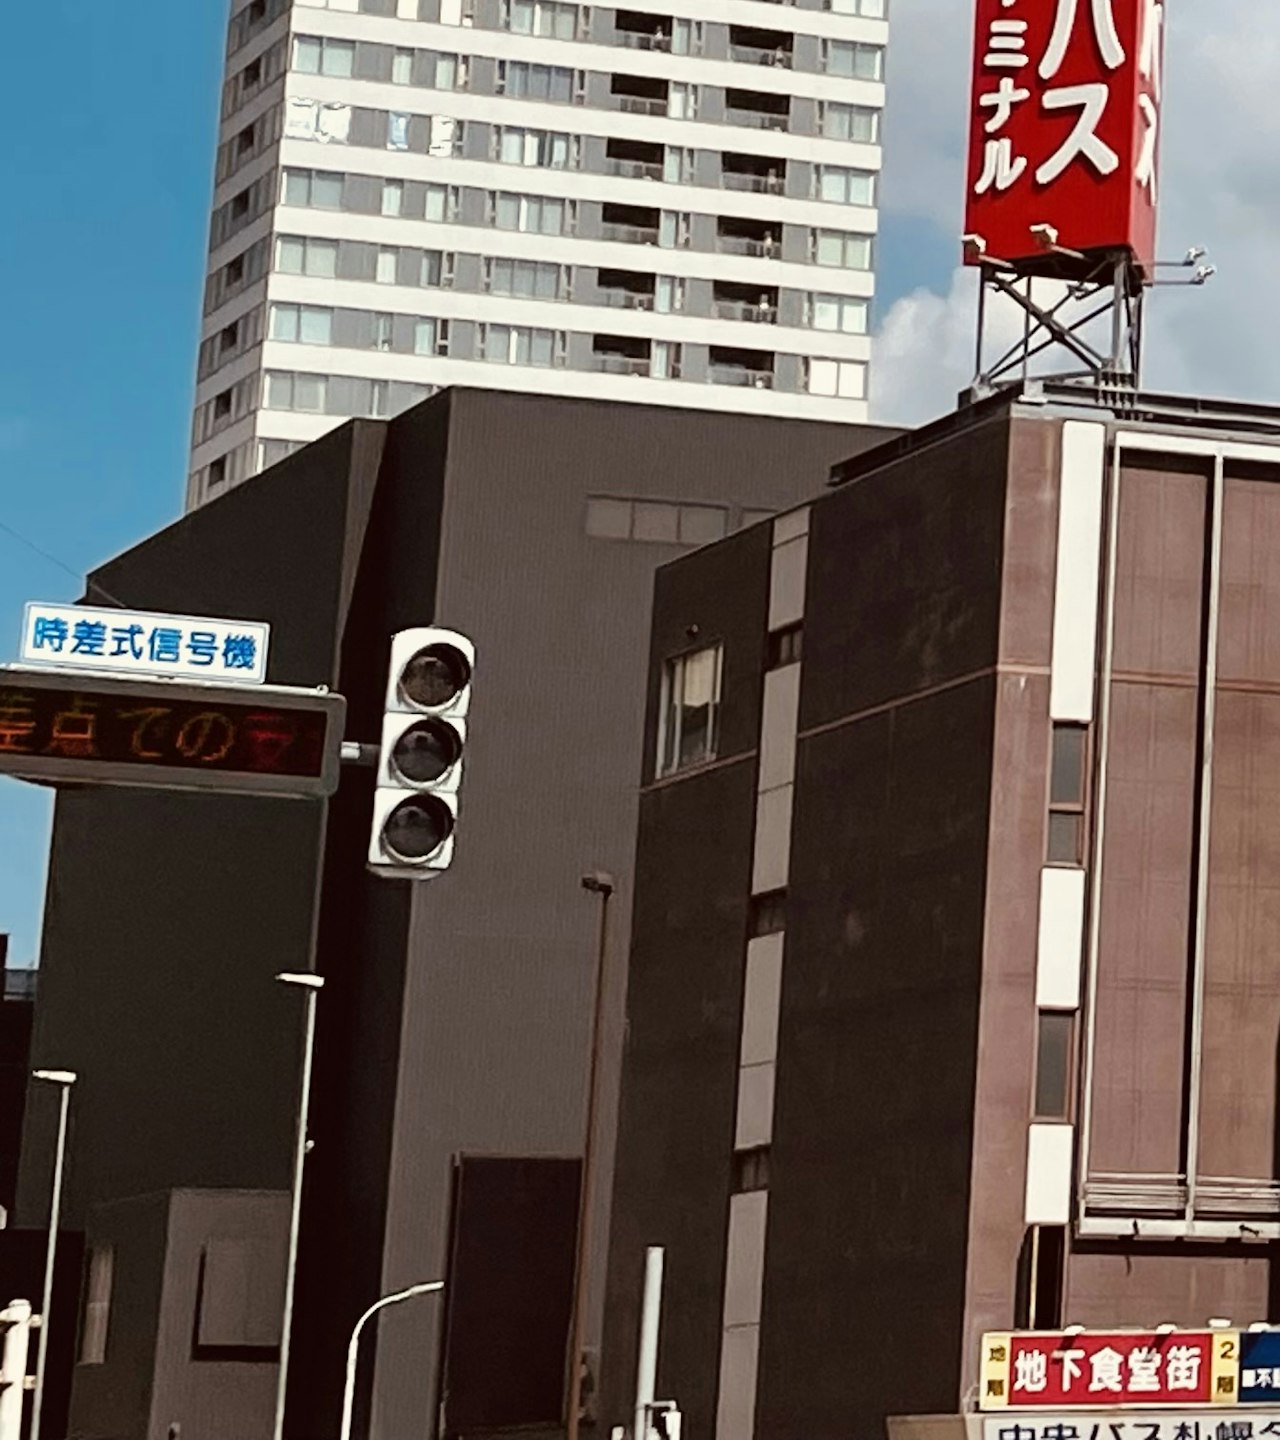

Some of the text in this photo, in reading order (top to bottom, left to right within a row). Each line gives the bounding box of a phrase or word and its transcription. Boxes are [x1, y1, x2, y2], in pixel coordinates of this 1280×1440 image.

[33, 616, 257, 669] 時差式信号機
[1013, 1346, 1201, 1393] 地下食堂街
